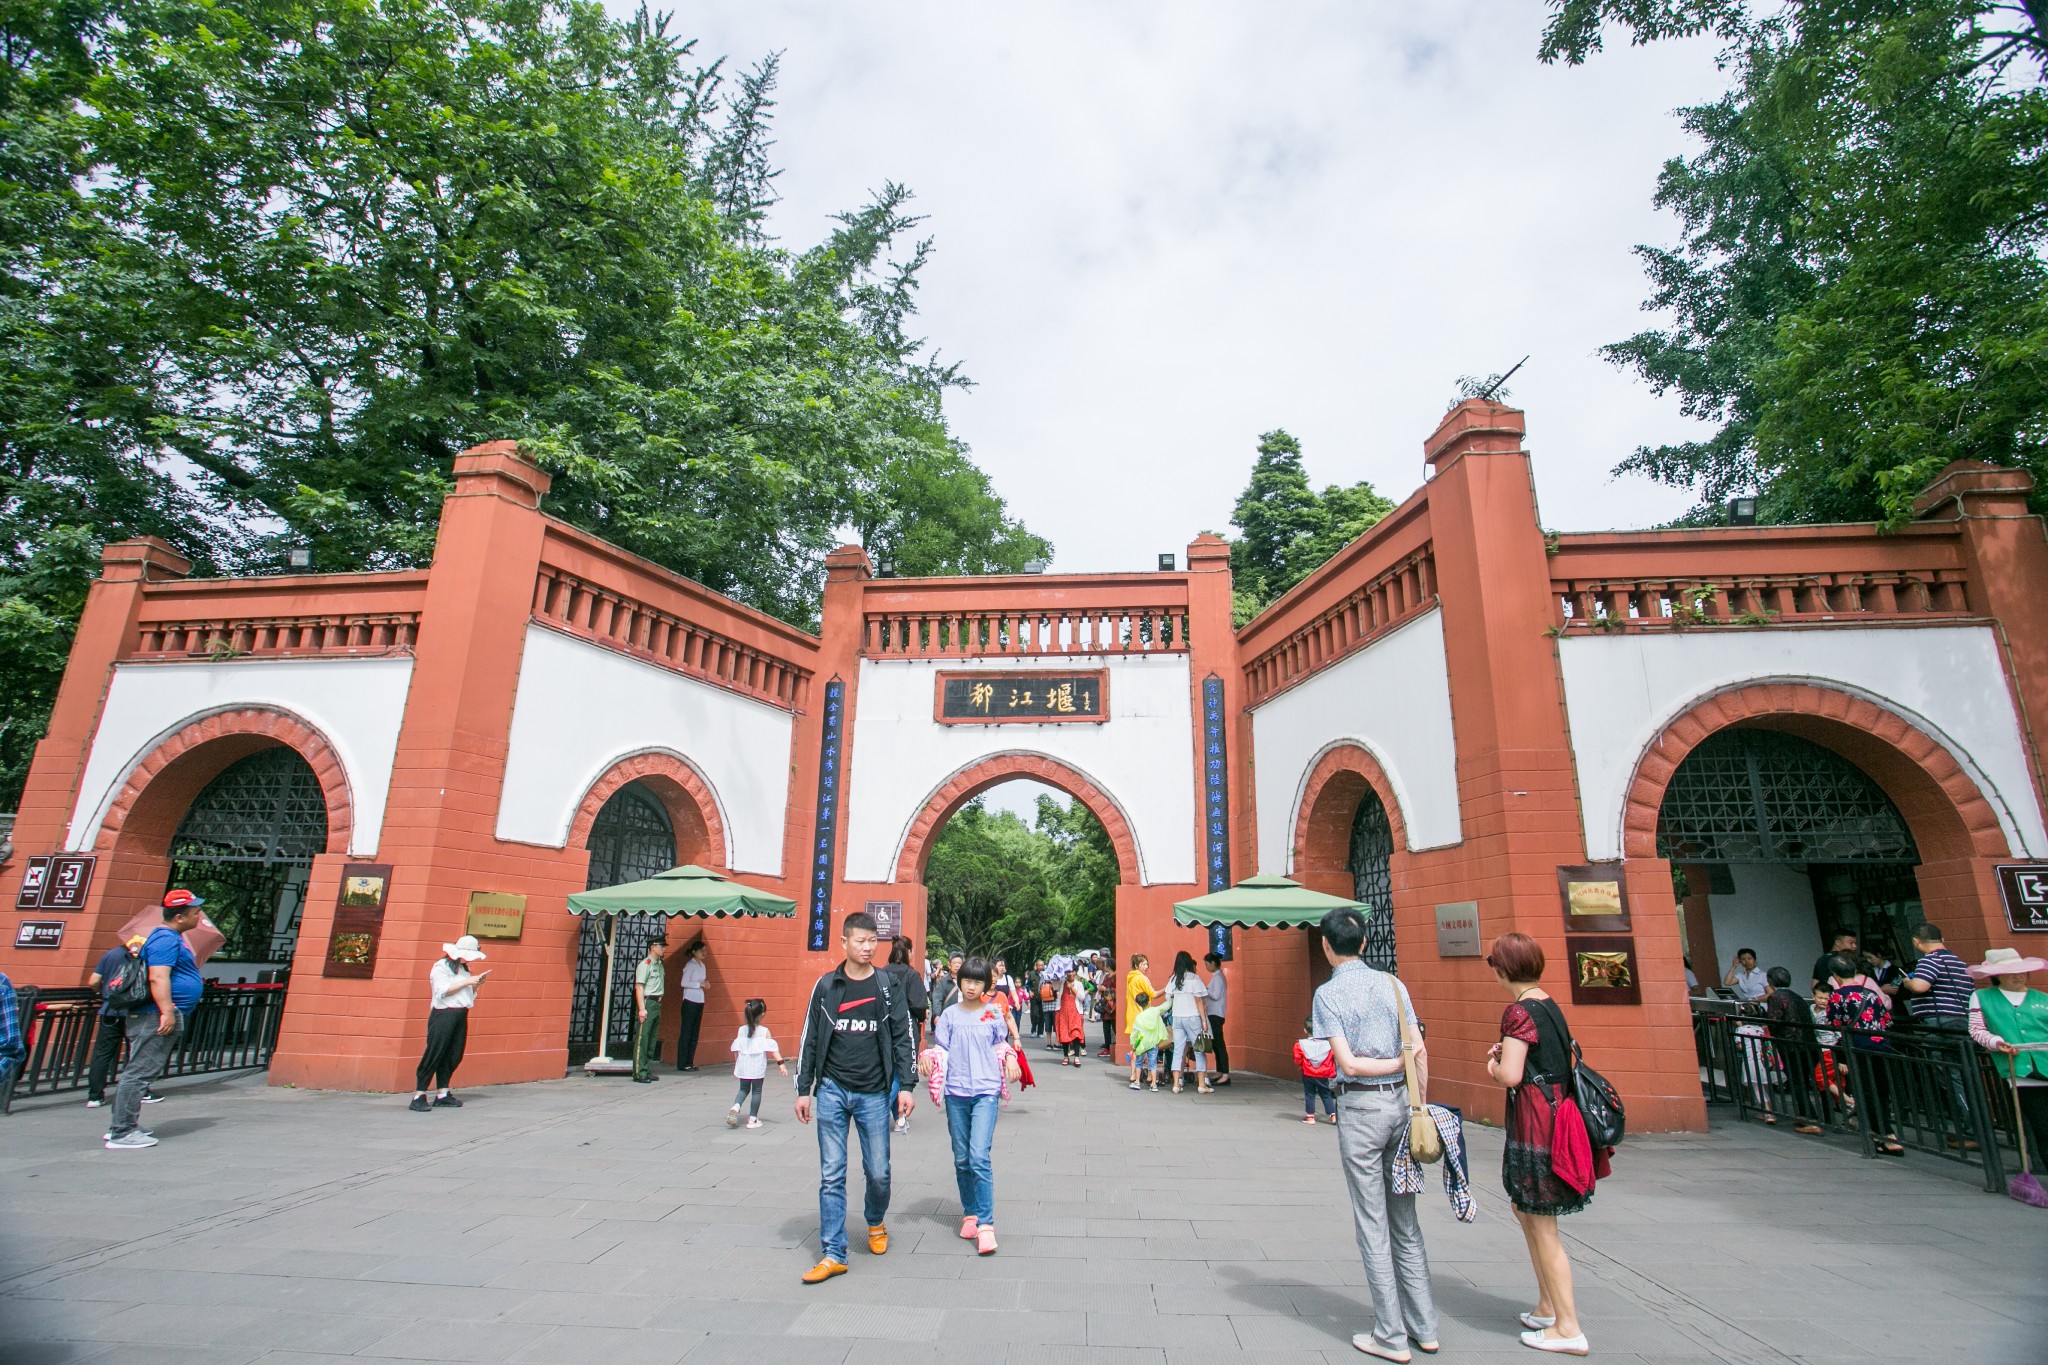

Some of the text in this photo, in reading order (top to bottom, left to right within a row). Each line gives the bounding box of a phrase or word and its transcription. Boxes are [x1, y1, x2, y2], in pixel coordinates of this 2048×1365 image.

[969, 682, 1077, 714] 都江堰
[54, 889, 75, 898] 入口
[851, 1019, 867, 1031] DO
